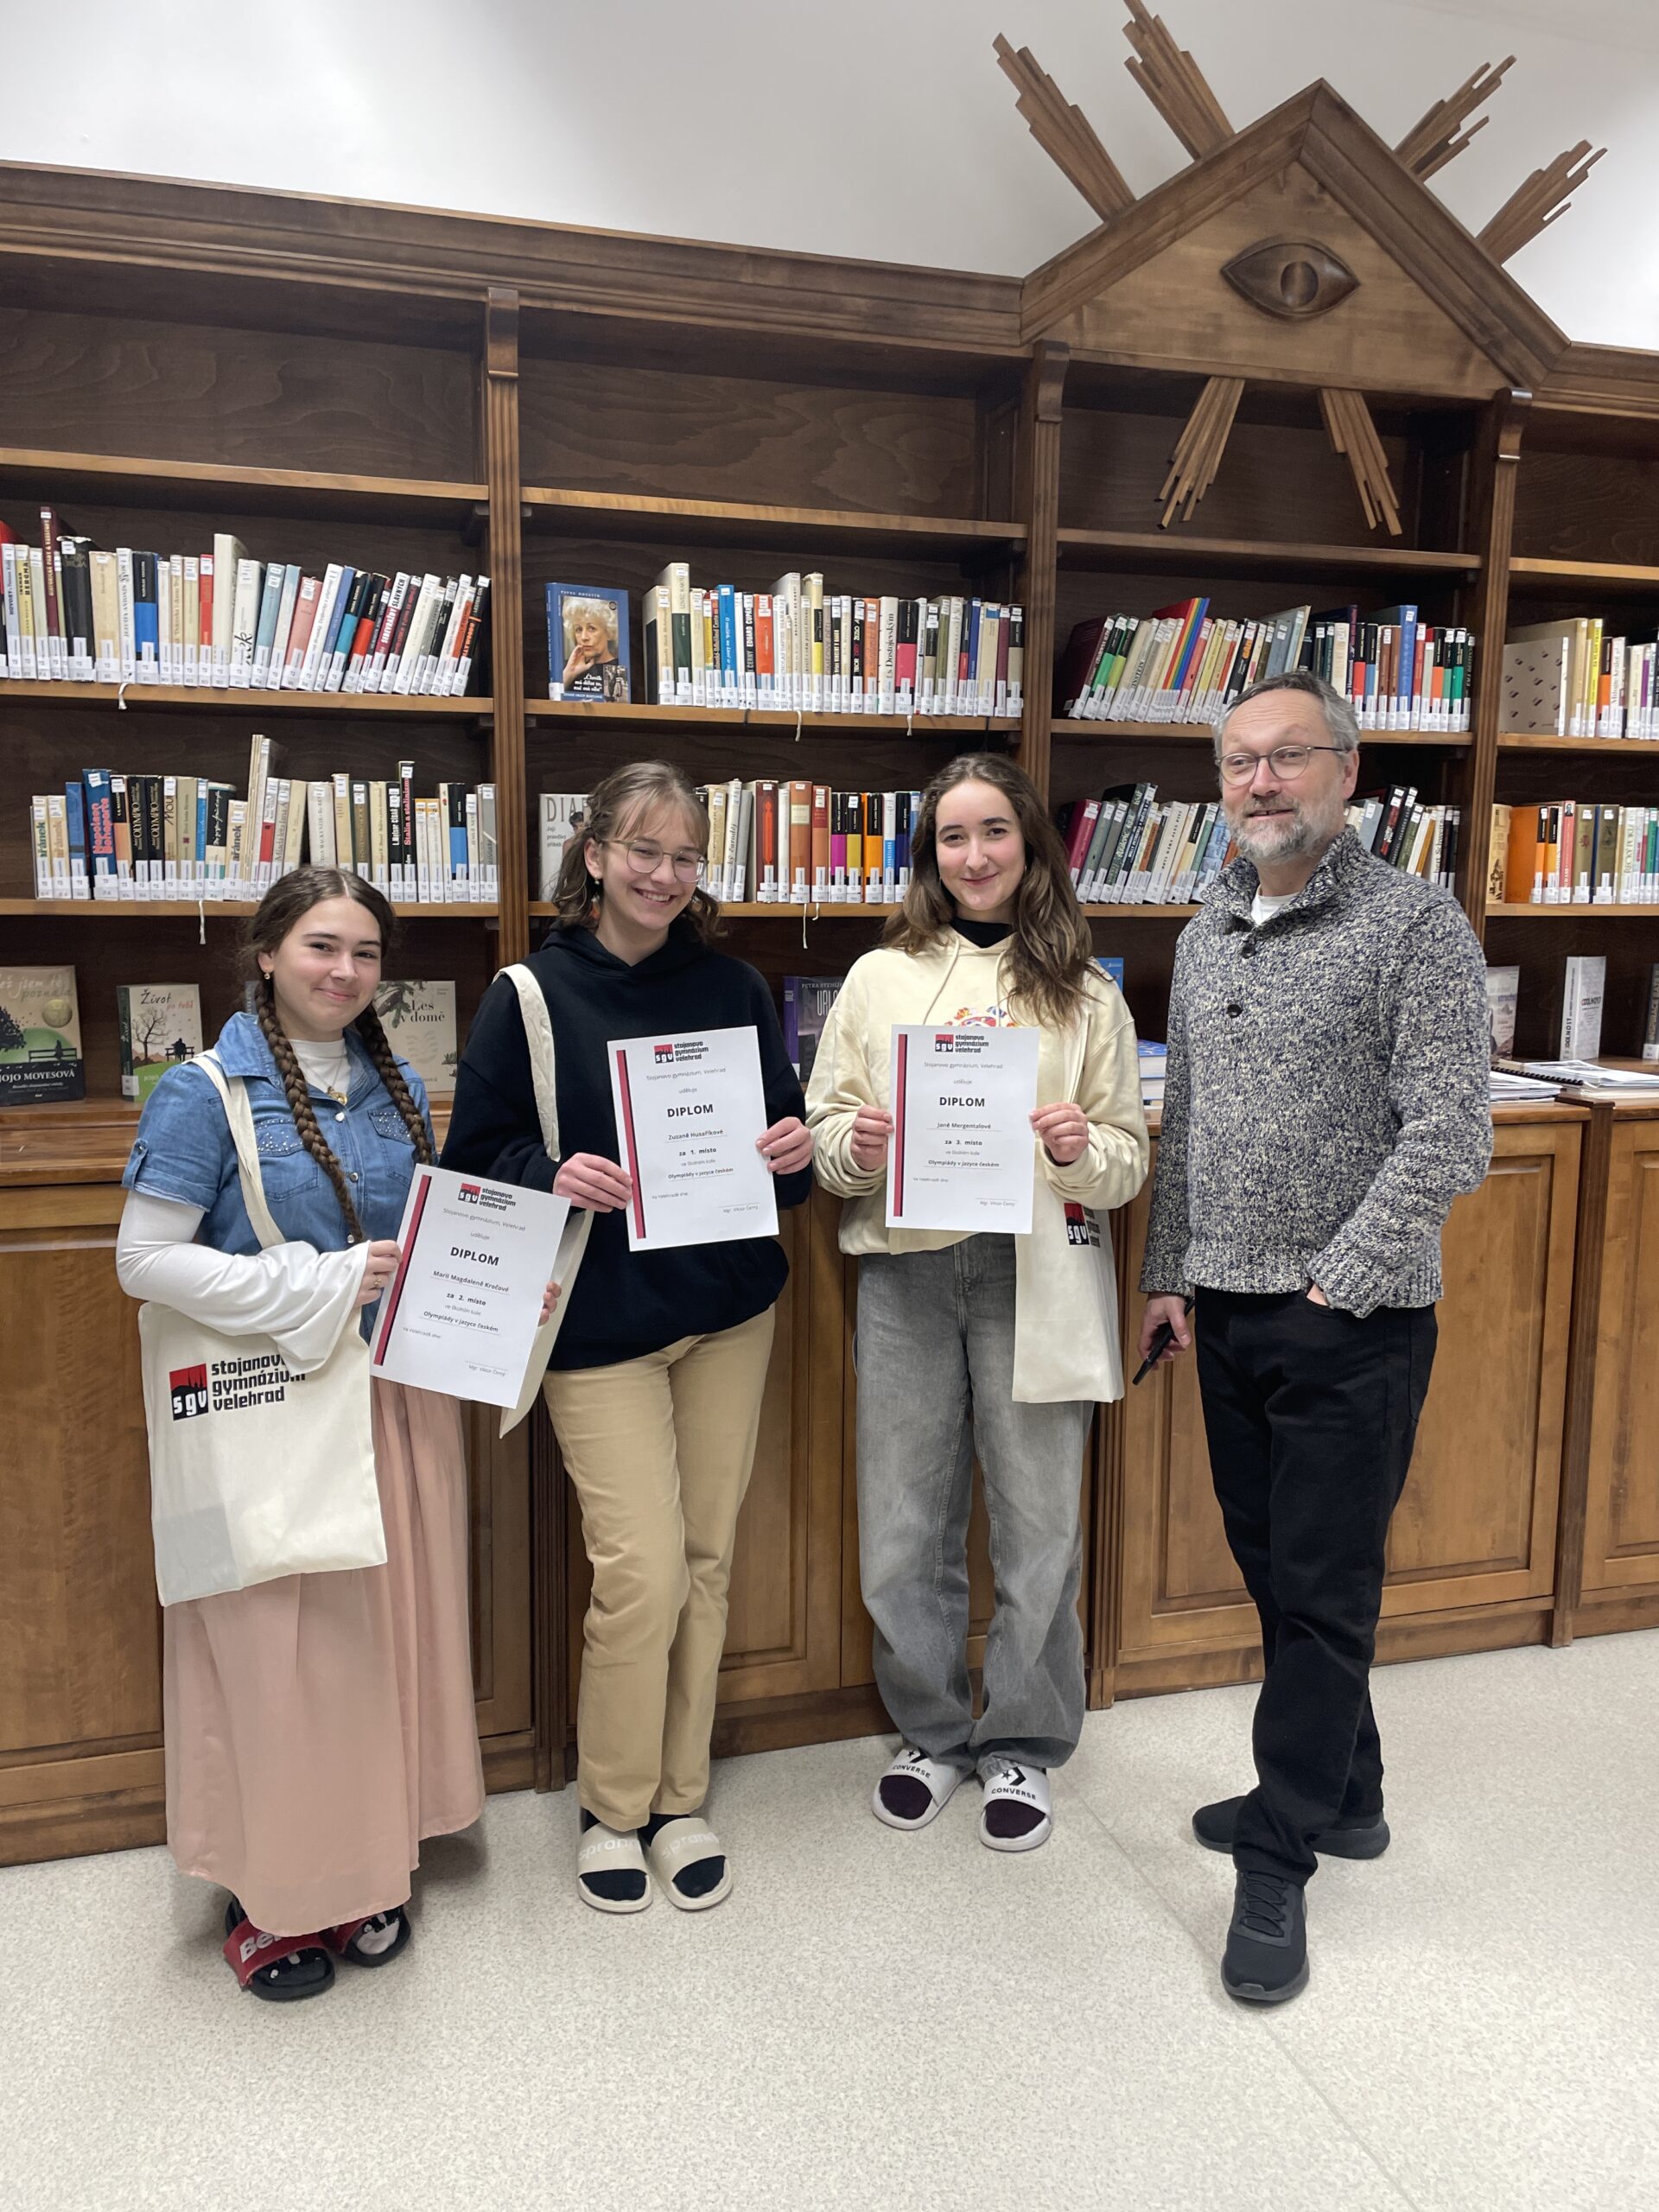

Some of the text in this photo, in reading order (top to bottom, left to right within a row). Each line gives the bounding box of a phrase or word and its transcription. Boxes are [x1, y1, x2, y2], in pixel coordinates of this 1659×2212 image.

[380, 607, 397, 644] SEBEVRAŽDY
[391, 579, 406, 607] SLAVNÝCH
[885, 613, 895, 667] Dostojevským
[546, 797, 588, 822] DIA
[100, 798, 113, 855] Bonaparte
[131, 803, 143, 838] OLYMPIO
[149, 802, 160, 838] OLYMPIO
[91, 803, 103, 855] Napoleon
[404, 823, 412, 846] Stalin
[728, 823, 737, 853] čaroděj
[141, 988, 172, 1004] Život
[411, 1000, 435, 1011] Les
[410, 1011, 445, 1022] domě
[675, 1046, 709, 1057] gymnázium
[935, 1043, 953, 1052] sgv
[655, 1053, 673, 1063] sgv
[23, 1070, 75, 1081] MOYESOVÁ
[939, 1096, 985, 1107] DIPLOM
[667, 1104, 714, 1117] DIPLOM
[668, 1132, 690, 1141] Zuzaně
[458, 1192, 479, 1204] sgv
[480, 1192, 517, 1206] gymnázium
[481, 1187, 512, 1198] stojanovo
[479, 1199, 507, 1211] velehrad
[1067, 1225, 1087, 1243] sgv
[450, 1247, 499, 1266] DIPLOM
[433, 1270, 509, 1293] Marii Magdaleně Kročové
[467, 1296, 486, 1306] místo
[423, 1311, 454, 1324] Olympiády
[459, 1319, 476, 1328] jazyce
[477, 1321, 499, 1332] českém
[211, 1354, 287, 1376] stojanov
[173, 1390, 207, 1417] sgv
[213, 1386, 285, 1412] velehrad
[892, 1764, 931, 1779] CONVERSE
[991, 1788, 1037, 1801] CONVERSE
[239, 1932, 282, 1963] Be
